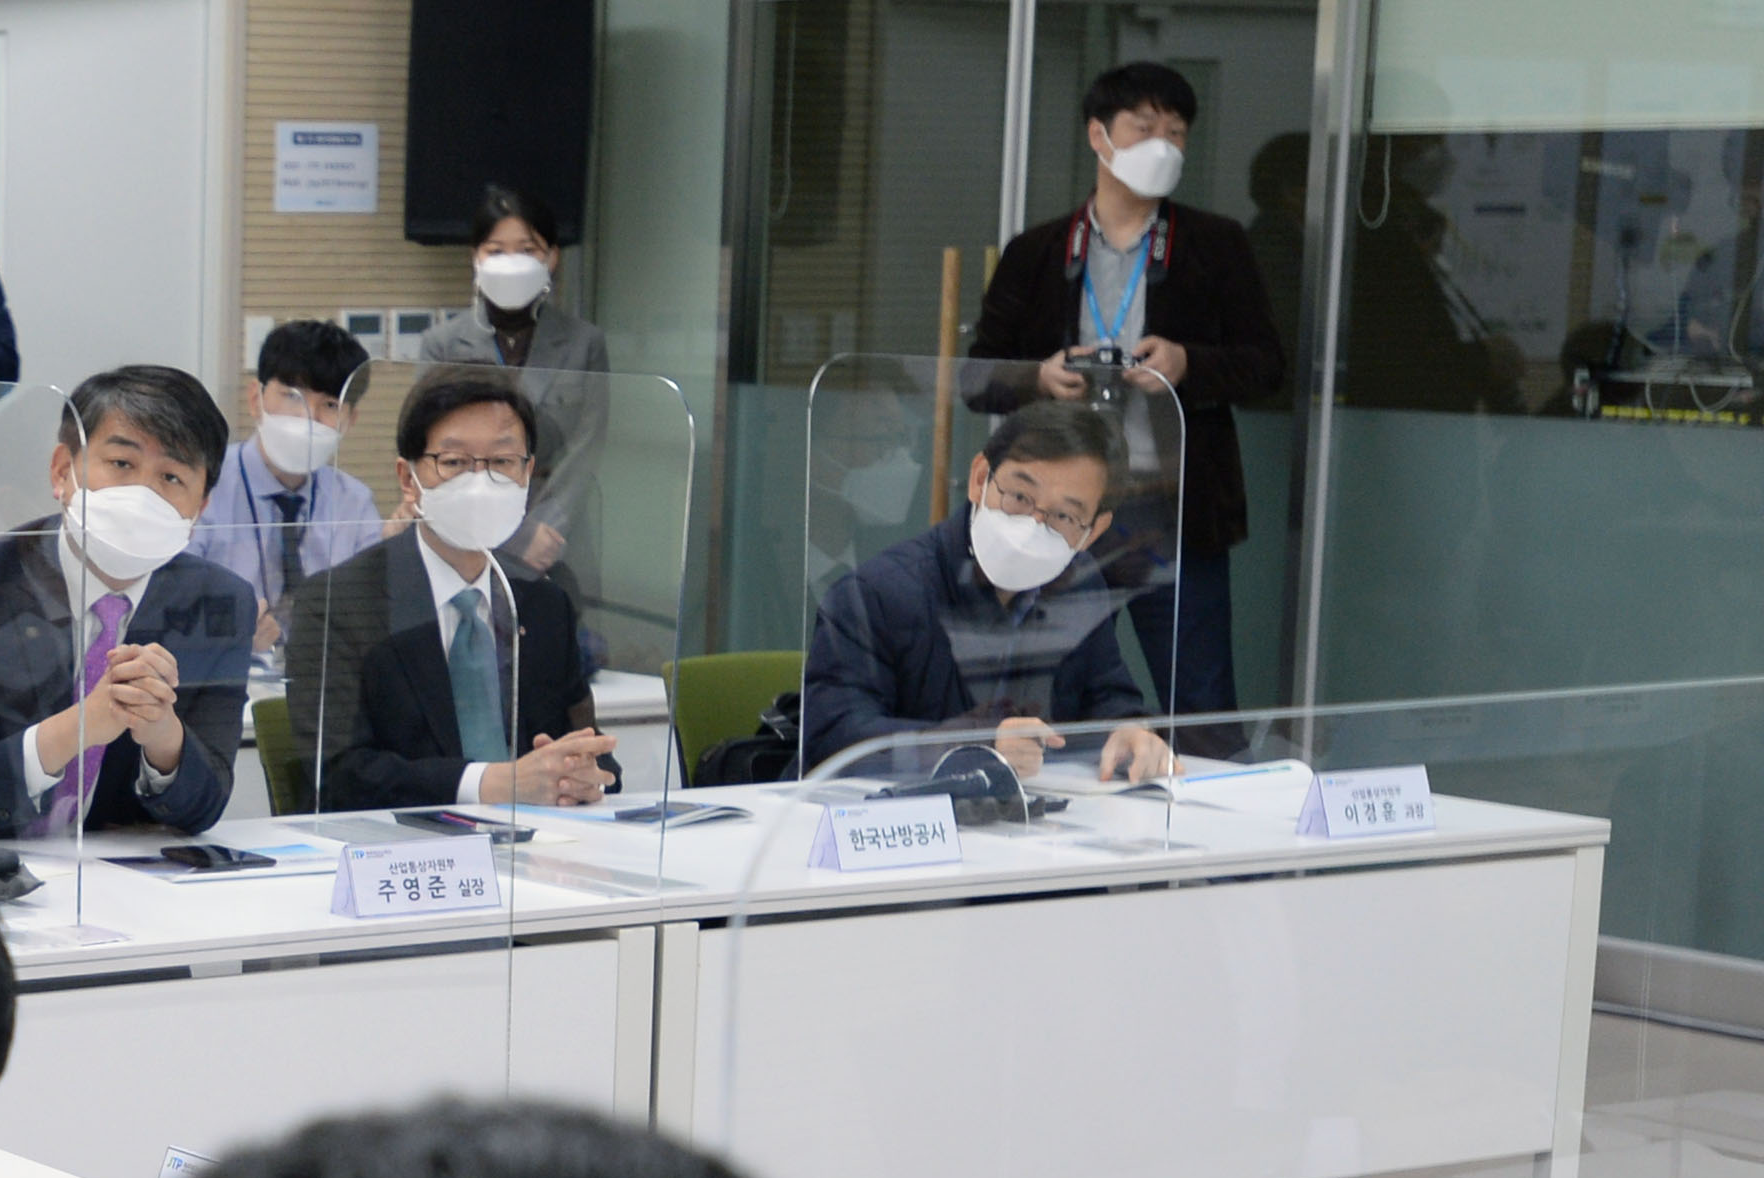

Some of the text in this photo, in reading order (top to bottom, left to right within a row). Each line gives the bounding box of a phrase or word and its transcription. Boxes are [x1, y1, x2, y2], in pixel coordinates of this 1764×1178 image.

[849, 822, 946, 851] 한국난방공사
[388, 858, 456, 875] 산업통상자원부
[458, 877, 485, 898] 실장
